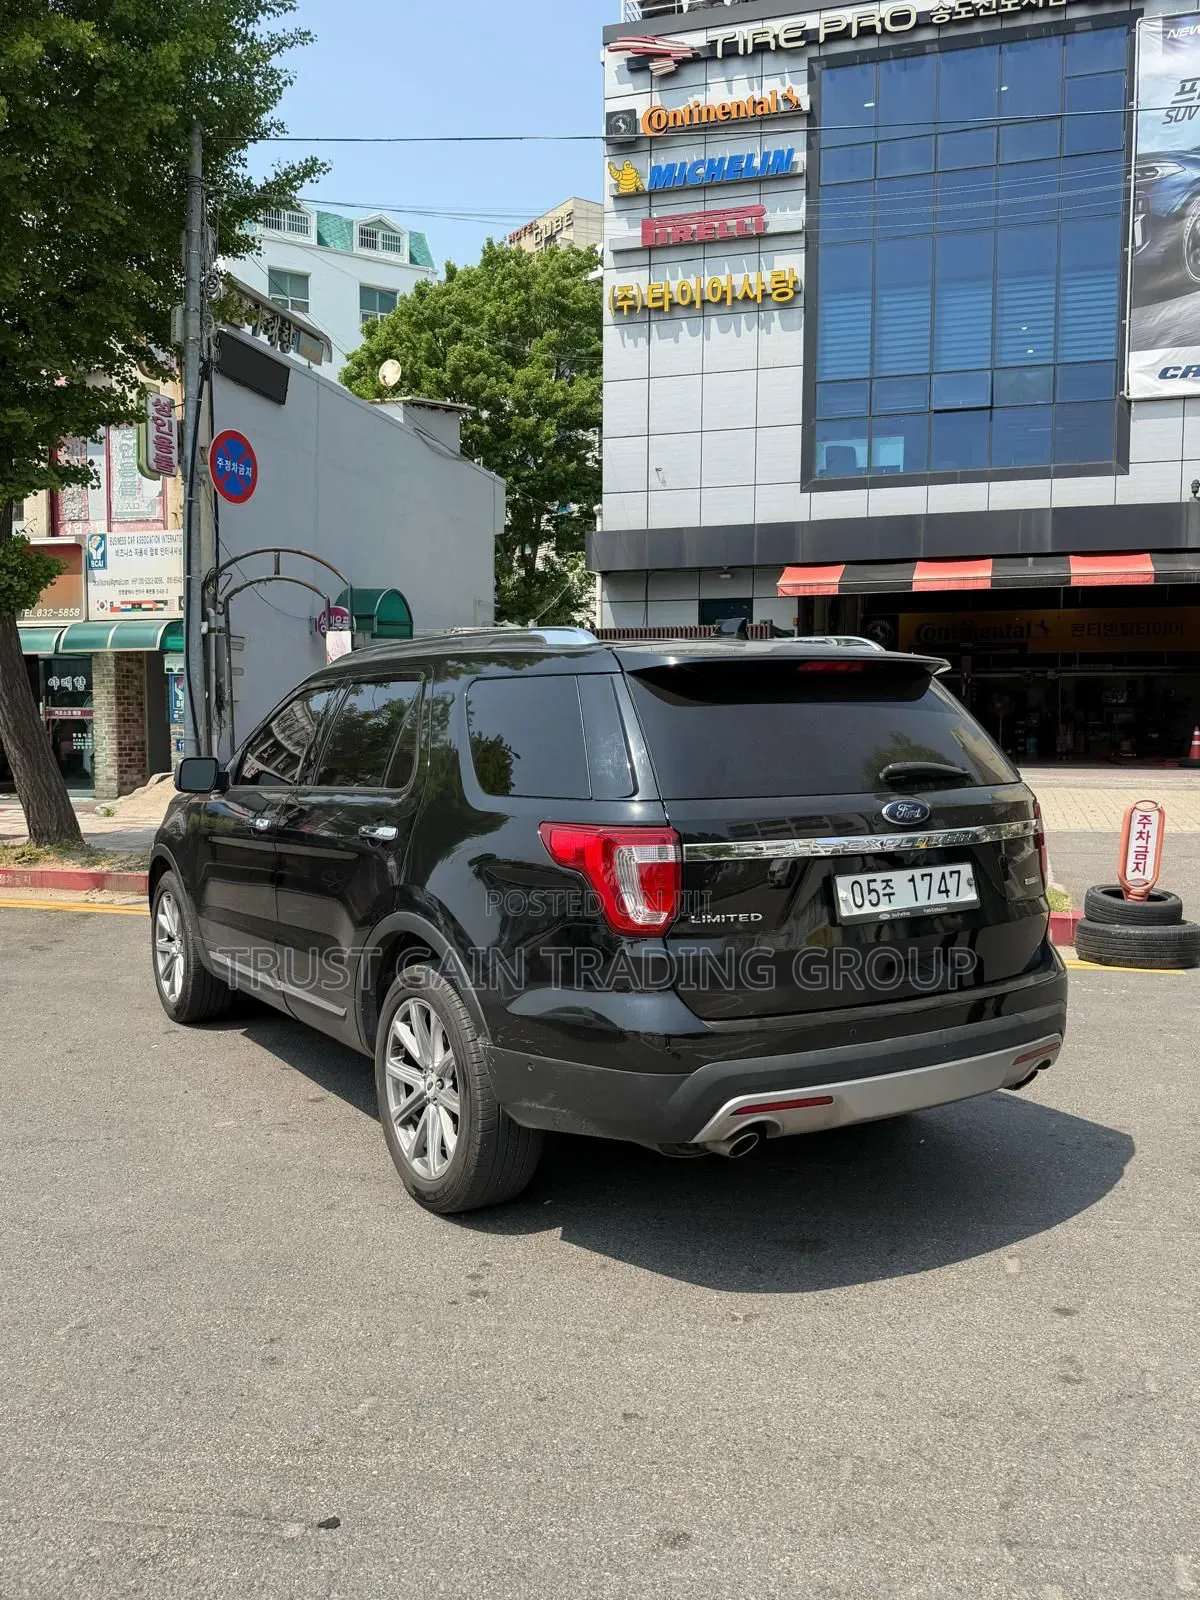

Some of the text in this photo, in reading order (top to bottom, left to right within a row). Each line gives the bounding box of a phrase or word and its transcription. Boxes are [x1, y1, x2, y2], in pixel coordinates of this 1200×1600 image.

[708, 5, 917, 59] TIRE PRO
[641, 90, 778, 139] Continental
[1162, 105, 1200, 125] SUV
[648, 148, 795, 190] MICHELIN
[533, 208, 574, 246] CUBE
[641, 204, 767, 248] PIRELLI
[609, 267, 798, 317] (주)타이어사랑
[217, 456, 252, 478] 주정차금지
[896, 803, 922, 819] Ford
[1131, 814, 1153, 876] 주차금지
[850, 869, 962, 909] 05주 1747
[690, 912, 763, 924] LIMITED
